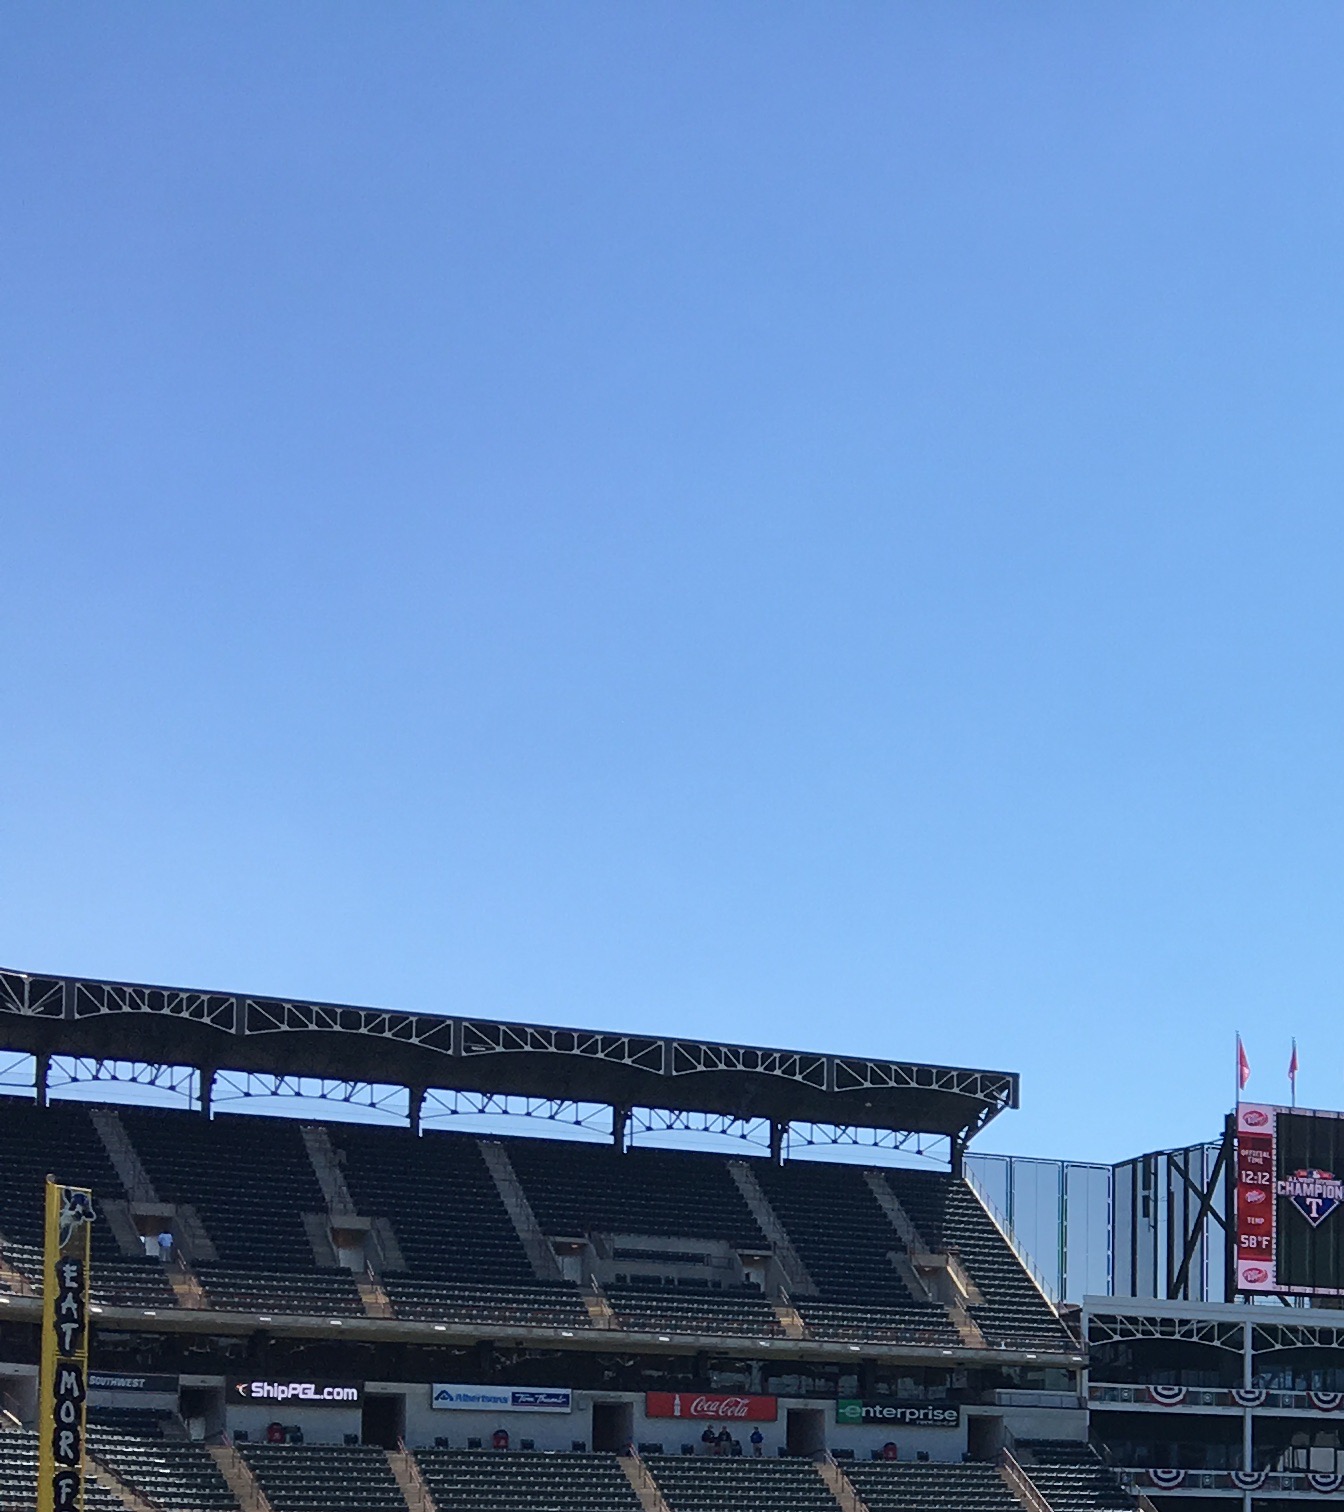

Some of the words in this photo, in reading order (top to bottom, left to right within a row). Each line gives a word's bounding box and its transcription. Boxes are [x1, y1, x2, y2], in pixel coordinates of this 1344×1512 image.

[1241, 1170, 1271, 1186] 12:12
[60, 1263, 80, 1353] EAT
[89, 1375, 146, 1388] SOUTHWEST
[251, 1381, 358, 1401] ShipPGL.com
[59, 1368, 80, 1459] MOR
[842, 1404, 959, 1423] enterprise
